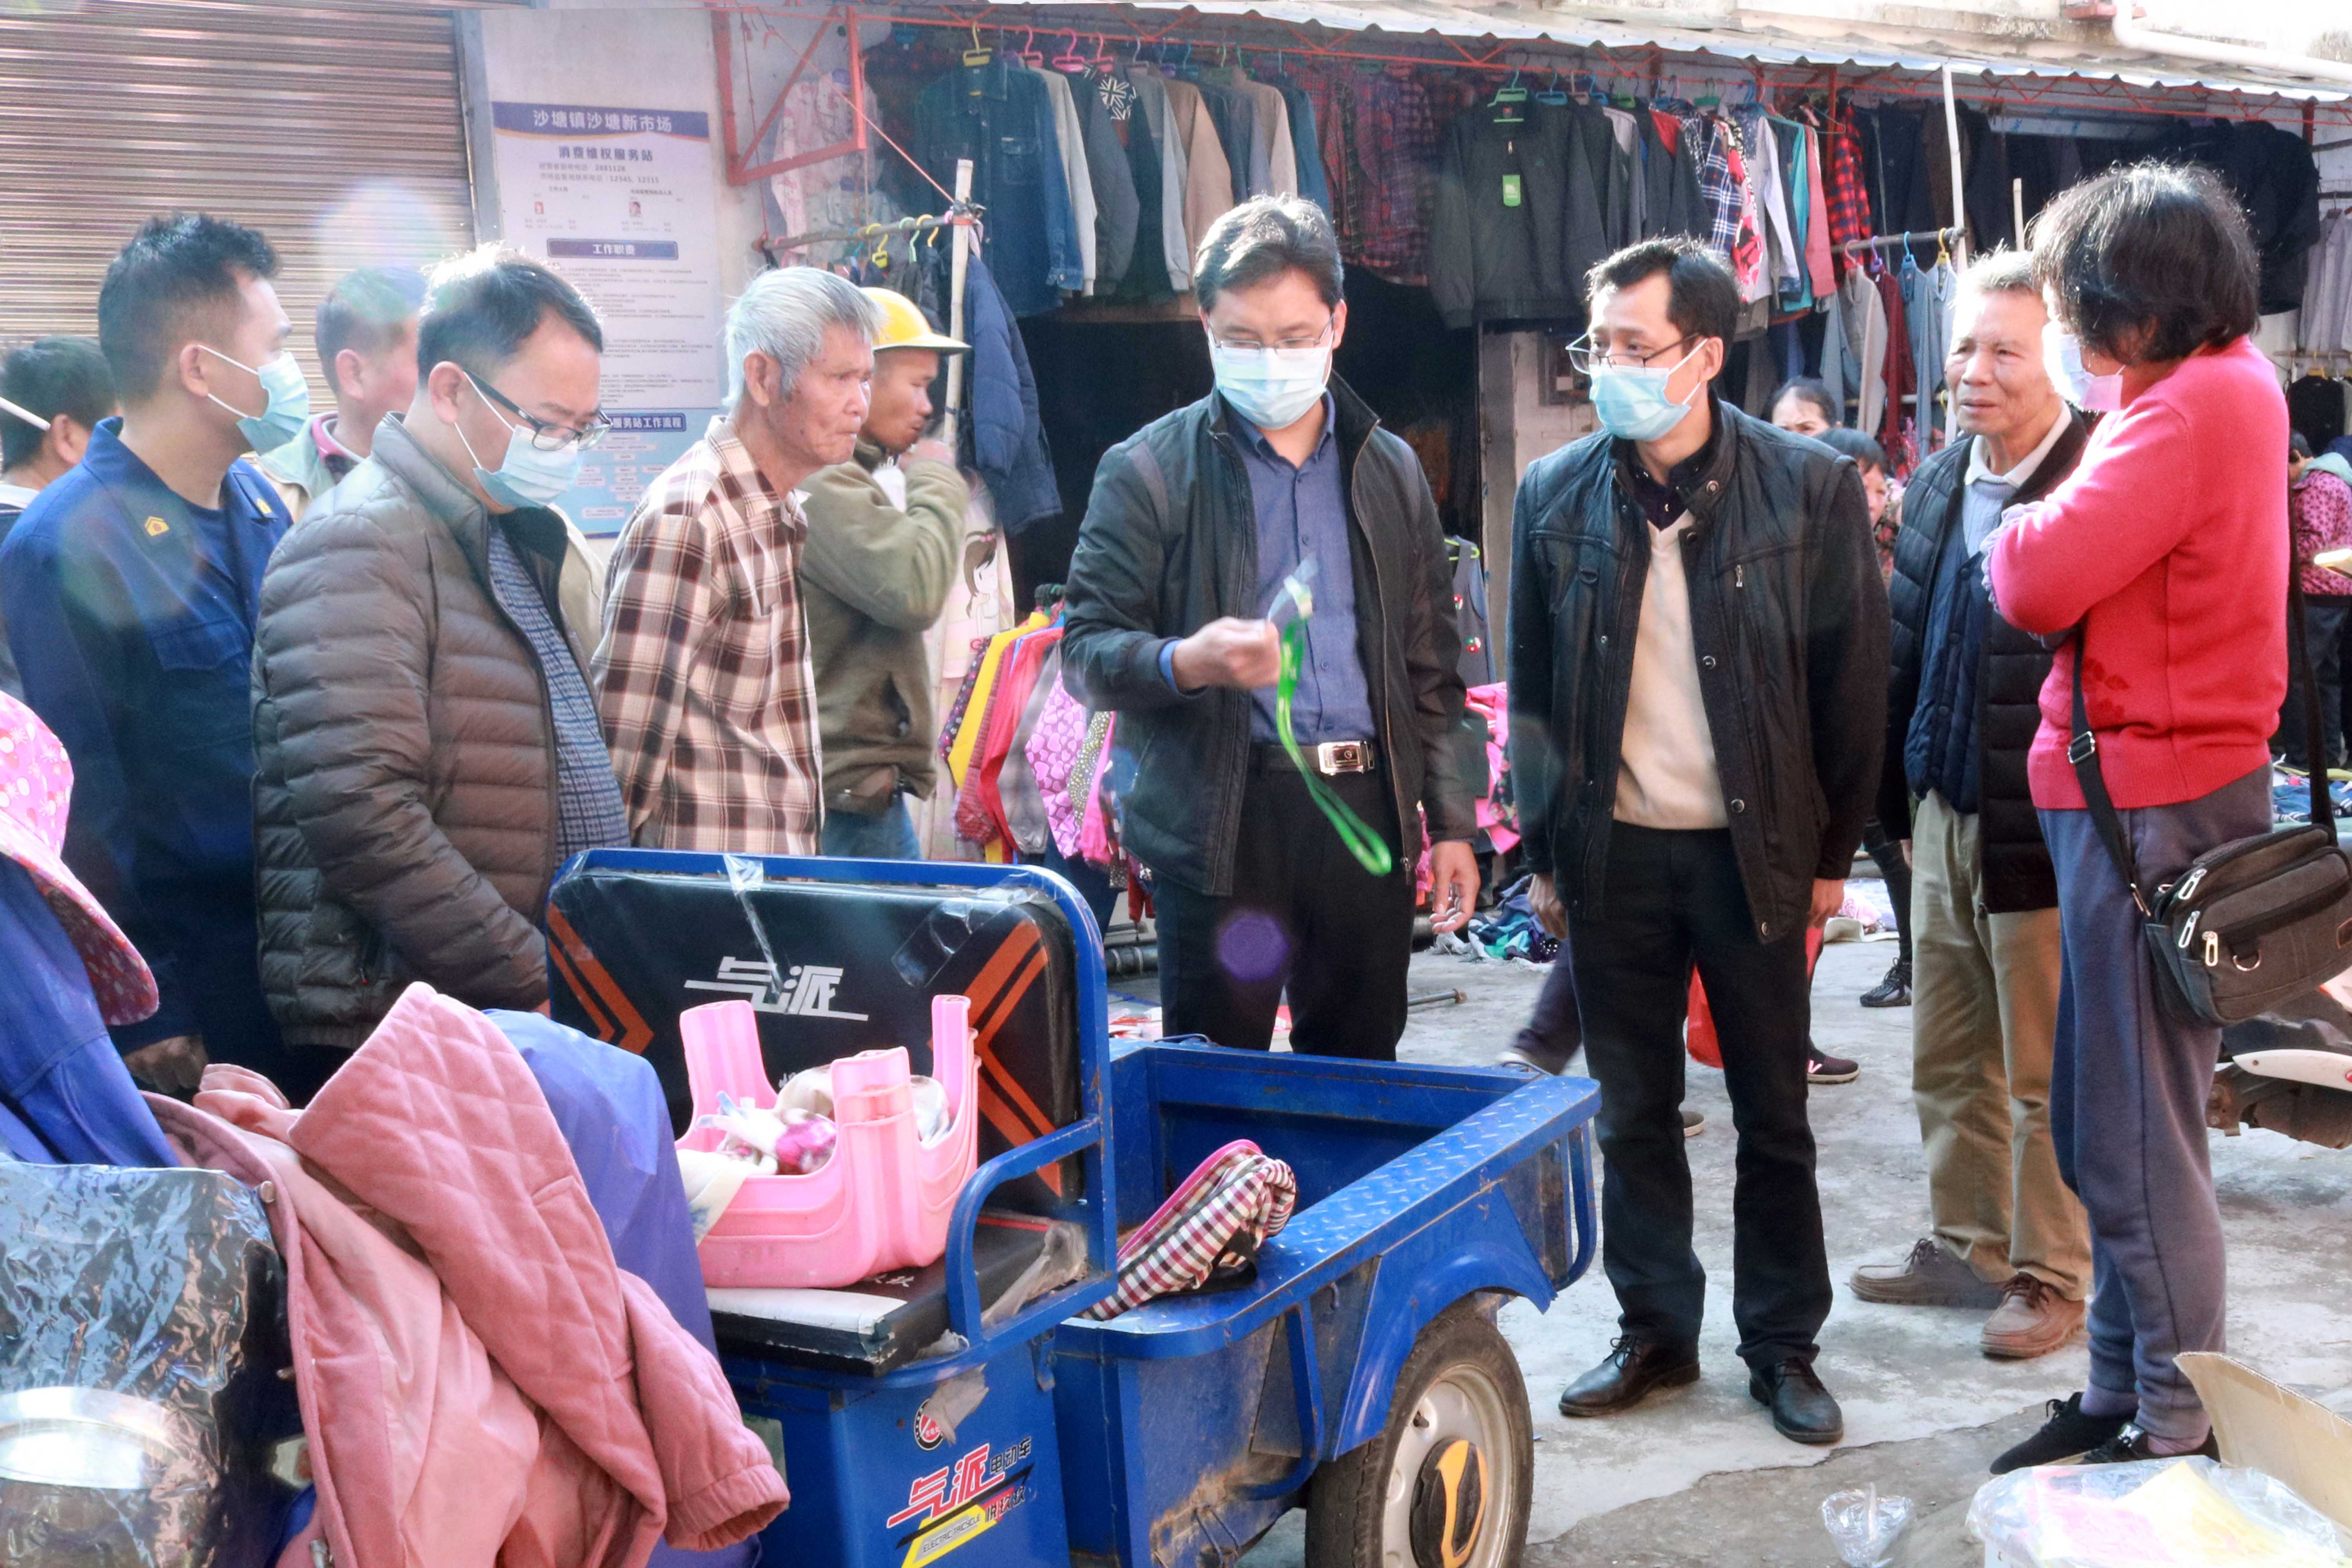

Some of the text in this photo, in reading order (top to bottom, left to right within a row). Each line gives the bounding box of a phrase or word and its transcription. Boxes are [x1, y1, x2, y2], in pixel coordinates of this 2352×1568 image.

[534, 109, 672, 133] 沙塘镇沙塘新市场
[559, 145, 653, 162] 消费维权服务站
[592, 243, 636, 256] 工作职责
[684, 956, 869, 1021] 气派
[886, 1436, 1032, 1528] 气派 电动车
